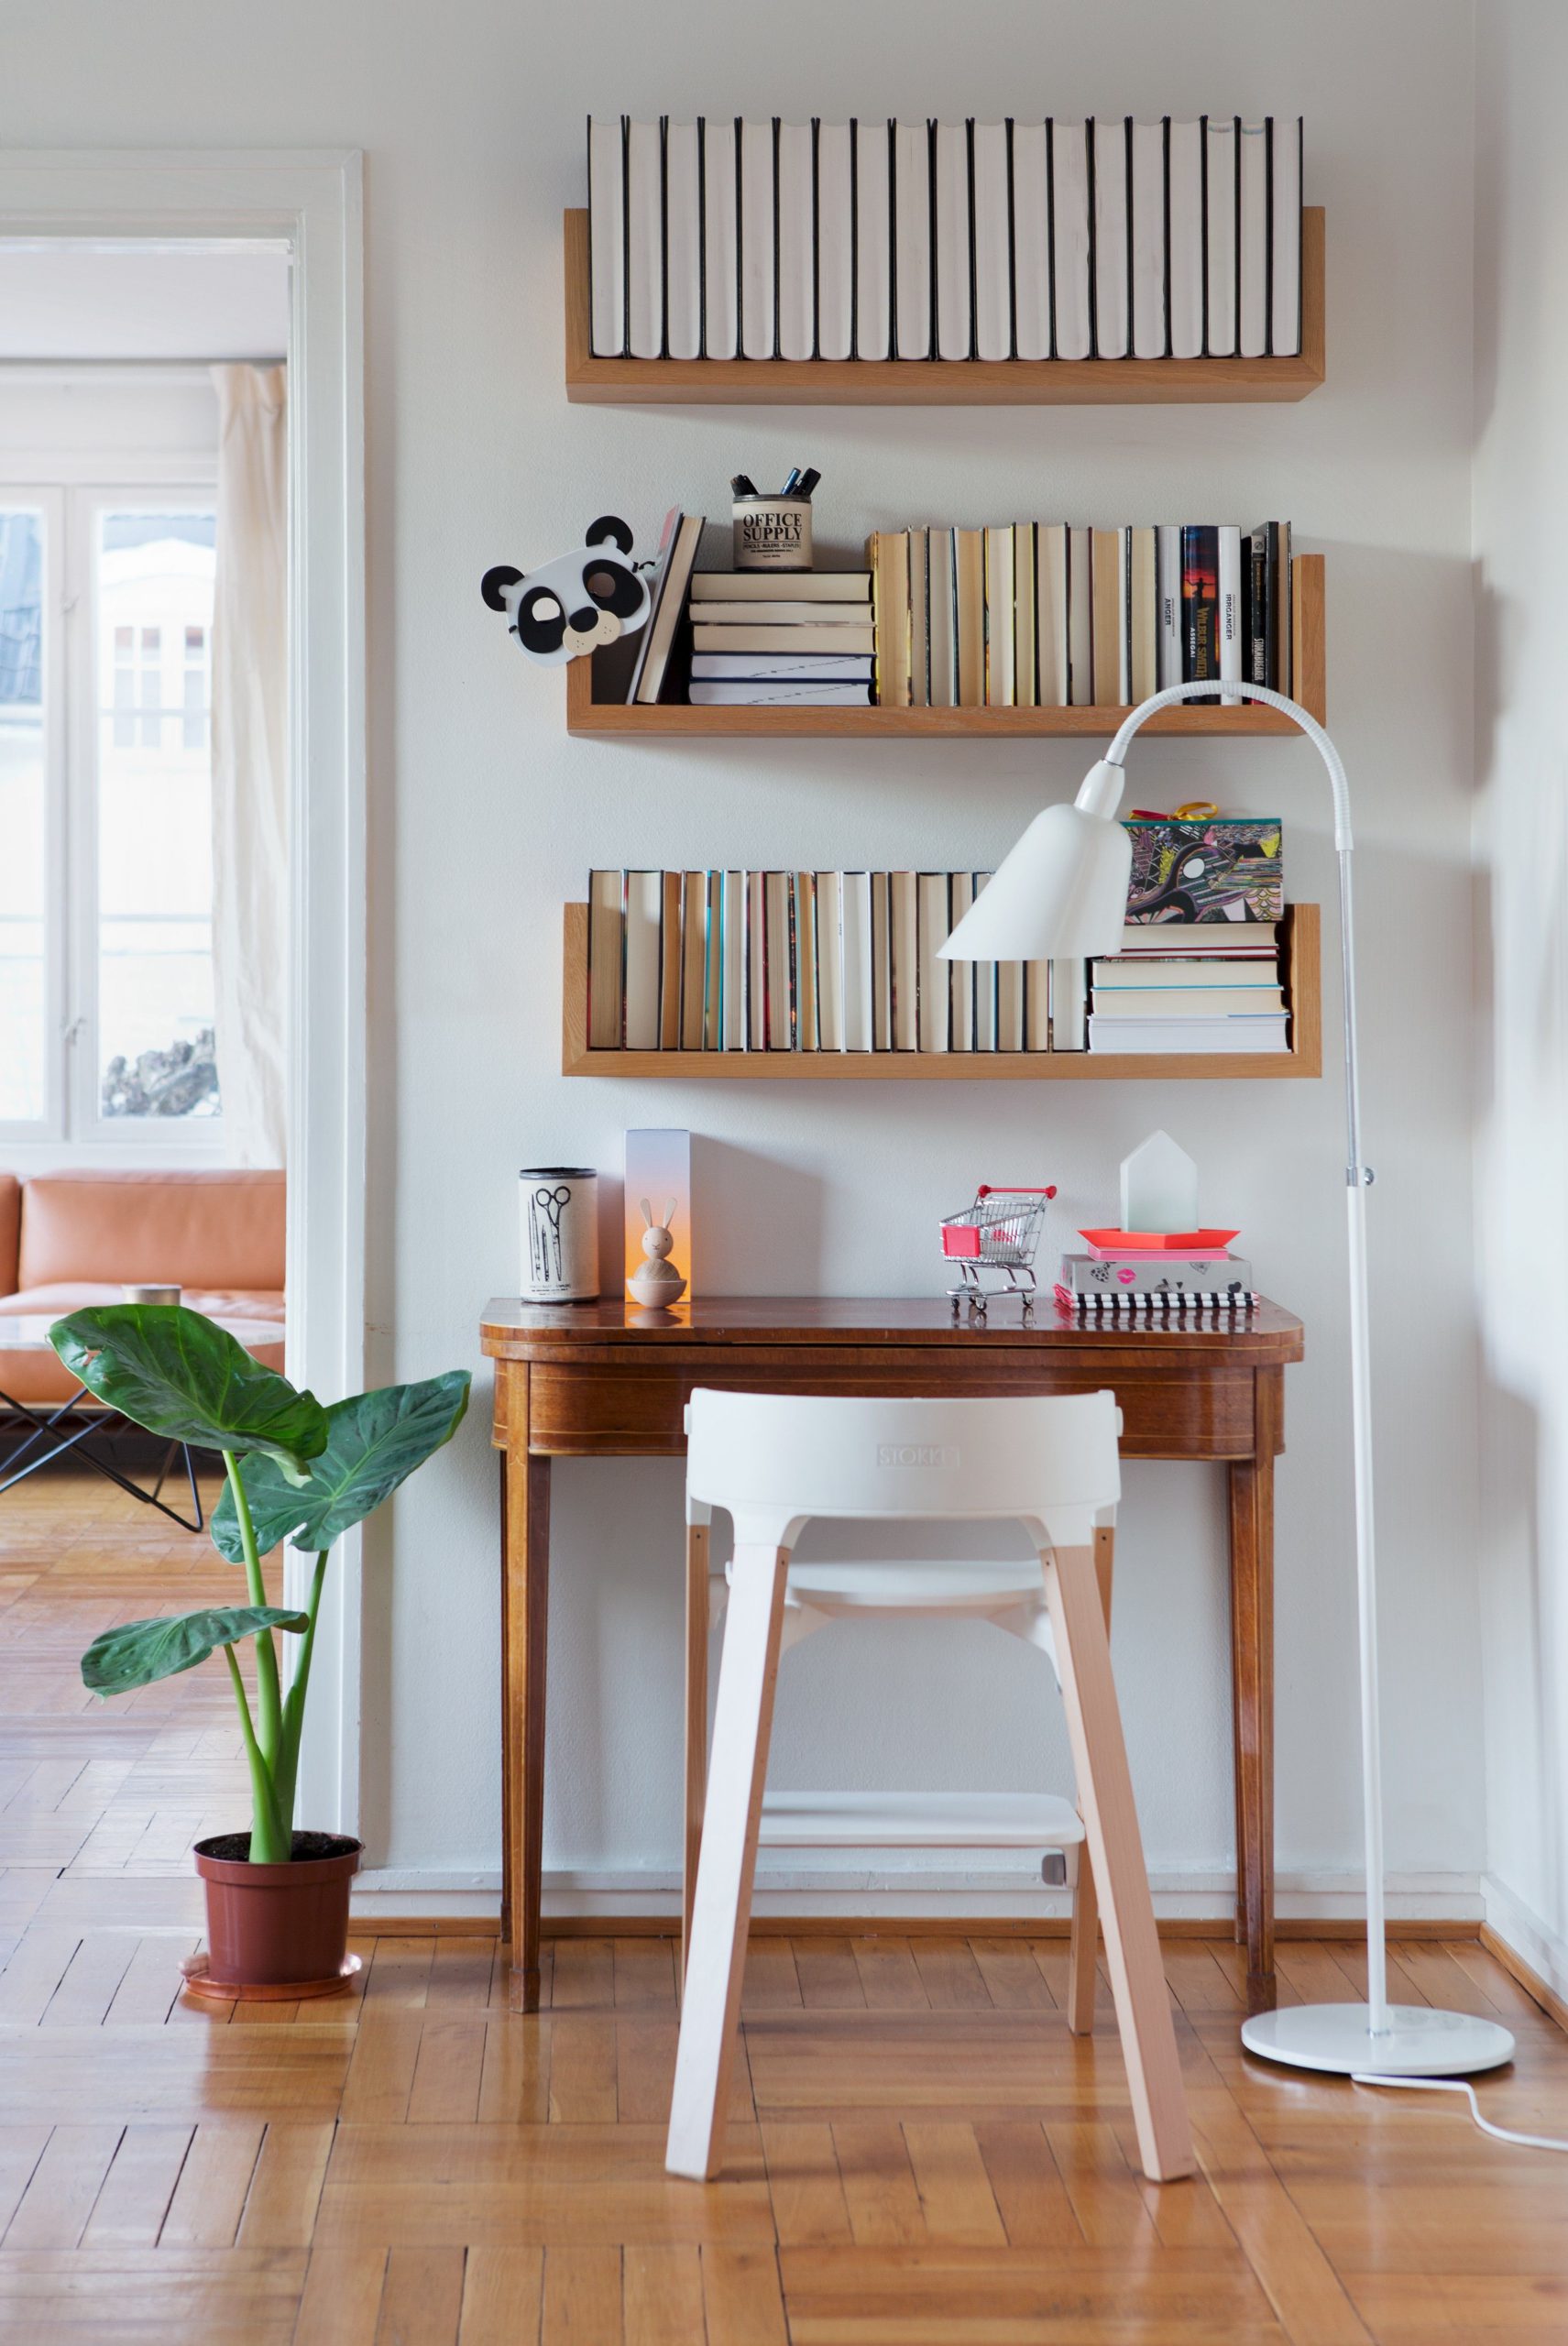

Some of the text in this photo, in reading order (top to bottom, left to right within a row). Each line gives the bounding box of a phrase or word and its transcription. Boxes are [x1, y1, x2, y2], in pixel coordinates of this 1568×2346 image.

[743, 513, 802, 527] OFFICE
[743, 527, 802, 542] SUPPLY
[1195, 607, 1210, 677] WILBUR SMITH
[1254, 638, 1265, 681] STORMBREAKER
